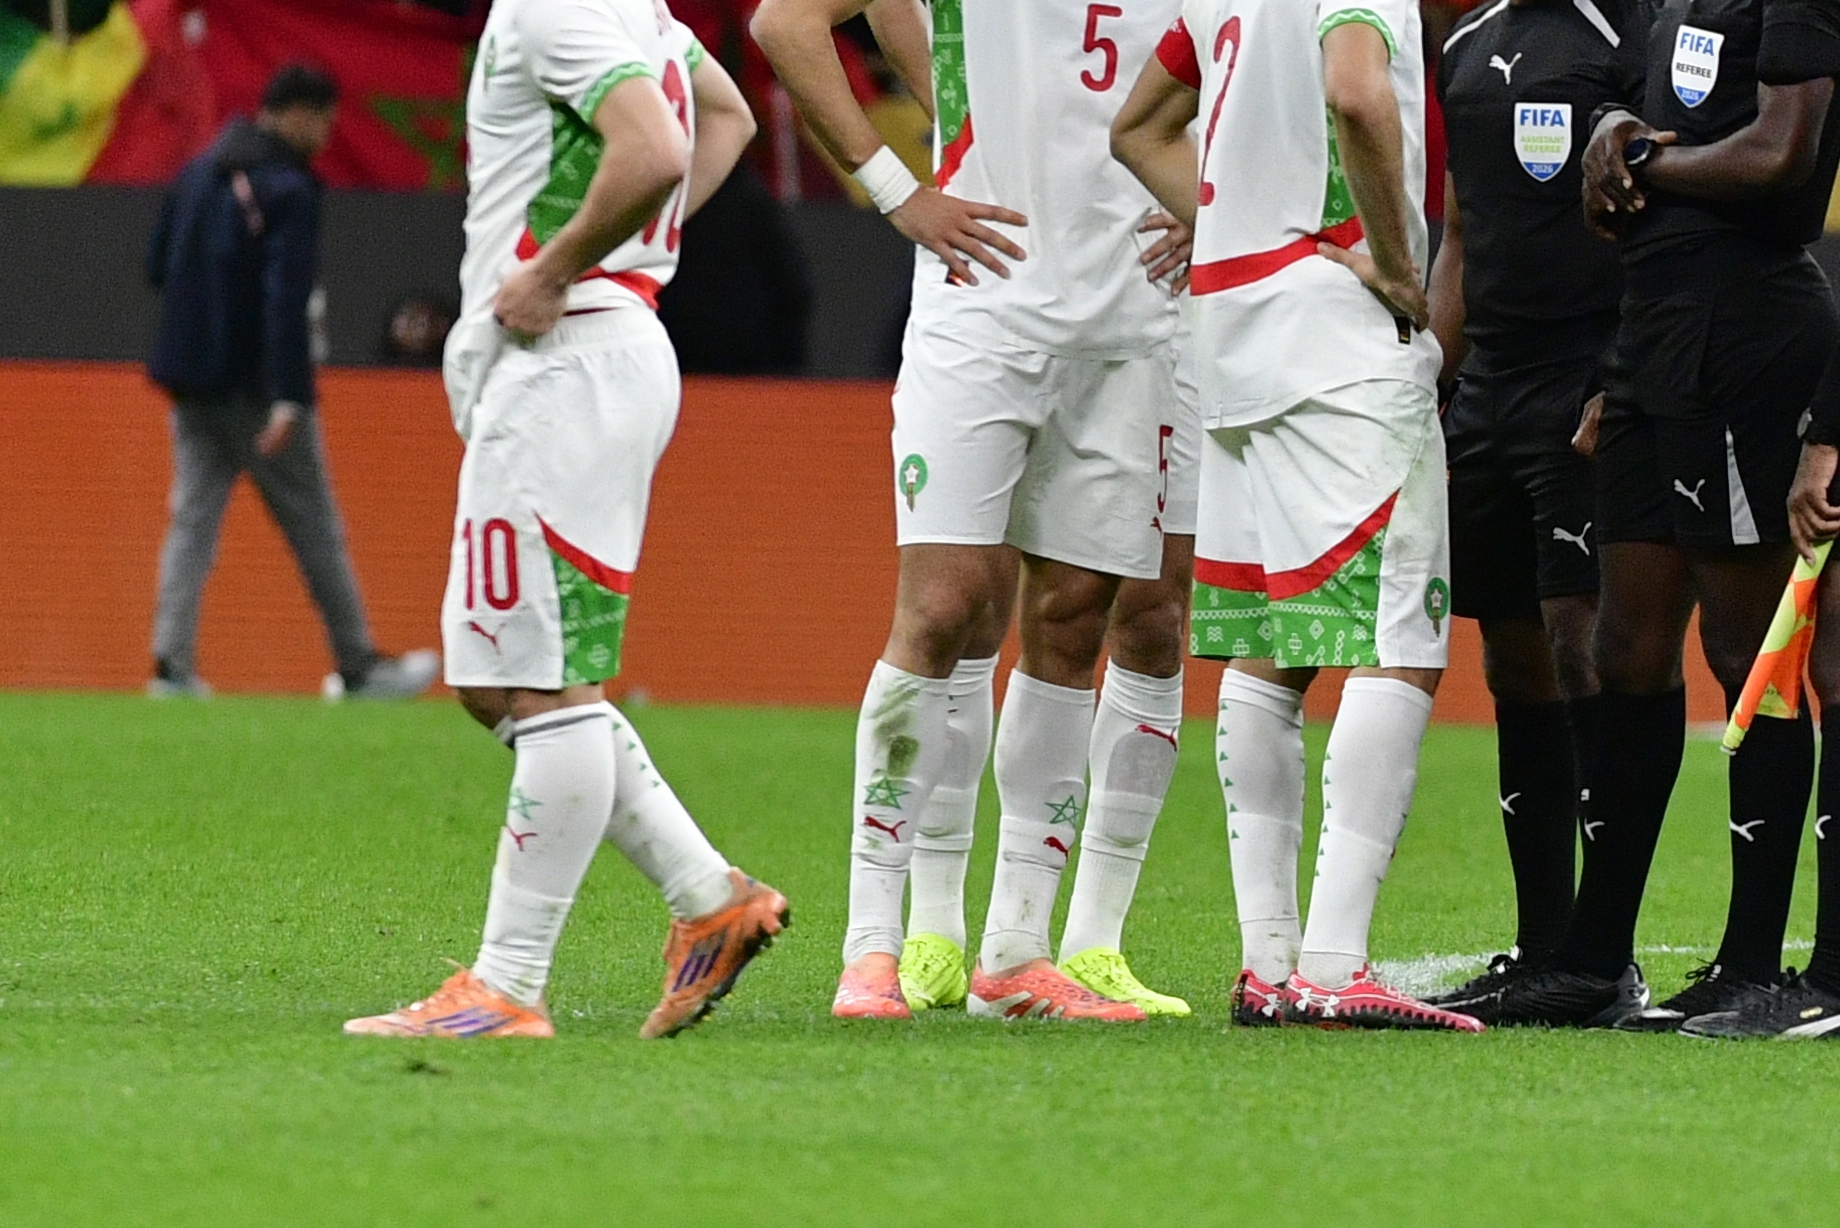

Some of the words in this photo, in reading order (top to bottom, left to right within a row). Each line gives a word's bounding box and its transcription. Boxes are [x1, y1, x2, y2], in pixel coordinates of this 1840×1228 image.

[1081, 4, 1122, 92] 5
[1680, 32, 1714, 57] FIFA
[1675, 62, 1713, 79] REFEREE
[1198, 16, 1241, 206] 2
[1519, 108, 1565, 127] FIFA
[1521, 135, 1566, 144] ASSISTANT
[1523, 144, 1562, 153] REFEREE
[1532, 164, 1554, 173] 2026
[462, 518, 519, 610] 10
